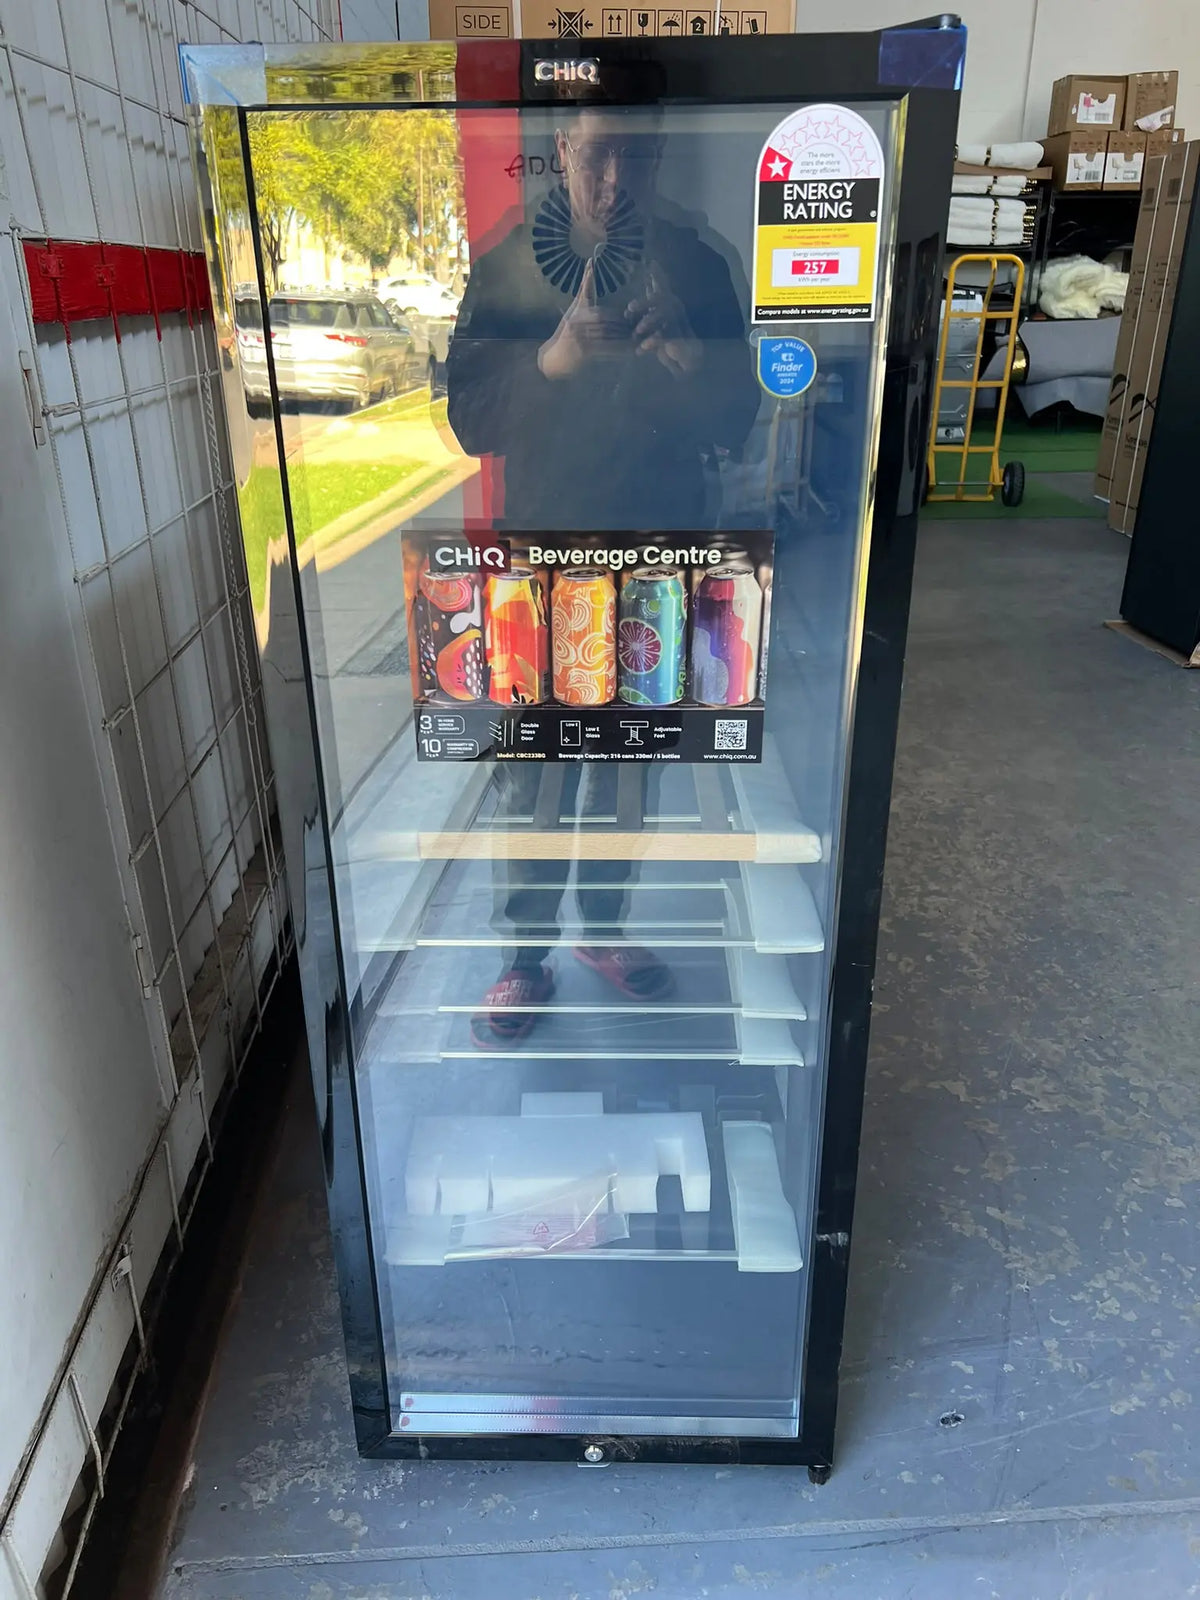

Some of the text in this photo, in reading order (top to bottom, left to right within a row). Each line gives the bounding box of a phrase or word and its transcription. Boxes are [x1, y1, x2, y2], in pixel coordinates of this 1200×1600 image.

[463, 15, 502, 29] SIDE
[534, 61, 599, 83] CHiQ
[783, 182, 856, 201] ENERGY
[783, 202, 853, 220] RATING
[804, 262, 827, 274] 257
[757, 308, 781, 316] Compare
[807, 307, 869, 315] www.energyrating.gov.au
[784, 341, 806, 352] VALUE
[771, 362, 804, 373] Finder
[435, 546, 505, 568] CHiQ
[528, 545, 722, 570] Beverage Centre
[420, 715, 433, 730] 3
[421, 738, 442, 753] 10
